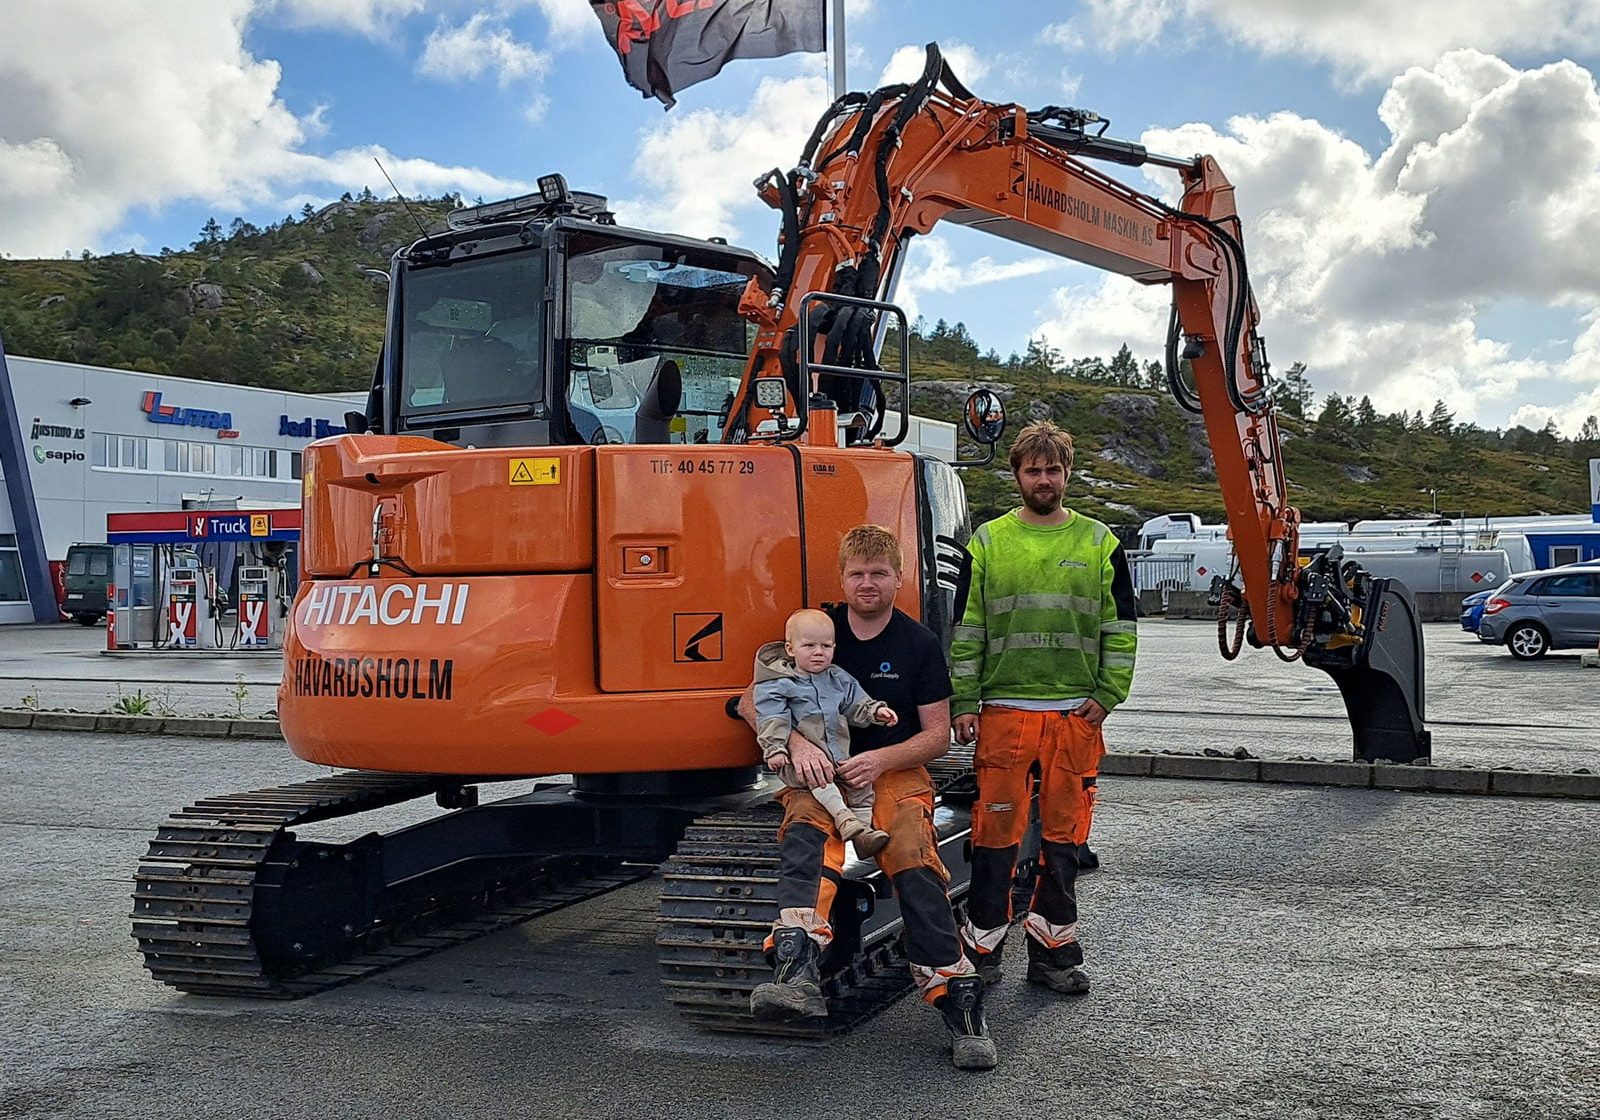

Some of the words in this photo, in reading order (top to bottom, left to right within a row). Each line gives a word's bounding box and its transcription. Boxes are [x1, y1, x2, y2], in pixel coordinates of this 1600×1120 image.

[1028, 178, 1100, 226] HÅVARDSHOLM
[1103, 210, 1139, 241] MASKIN
[1141, 226, 1153, 246] AS
[45, 449, 85, 465] sapio
[677, 460, 694, 474] 40
[698, 460, 715, 474] 45
[719, 460, 734, 474] 77
[739, 460, 754, 474] 29
[210, 518, 247, 534] Truck
[303, 583, 470, 626] HITACHI
[295, 651, 453, 700] HÅVARDSHOLM
